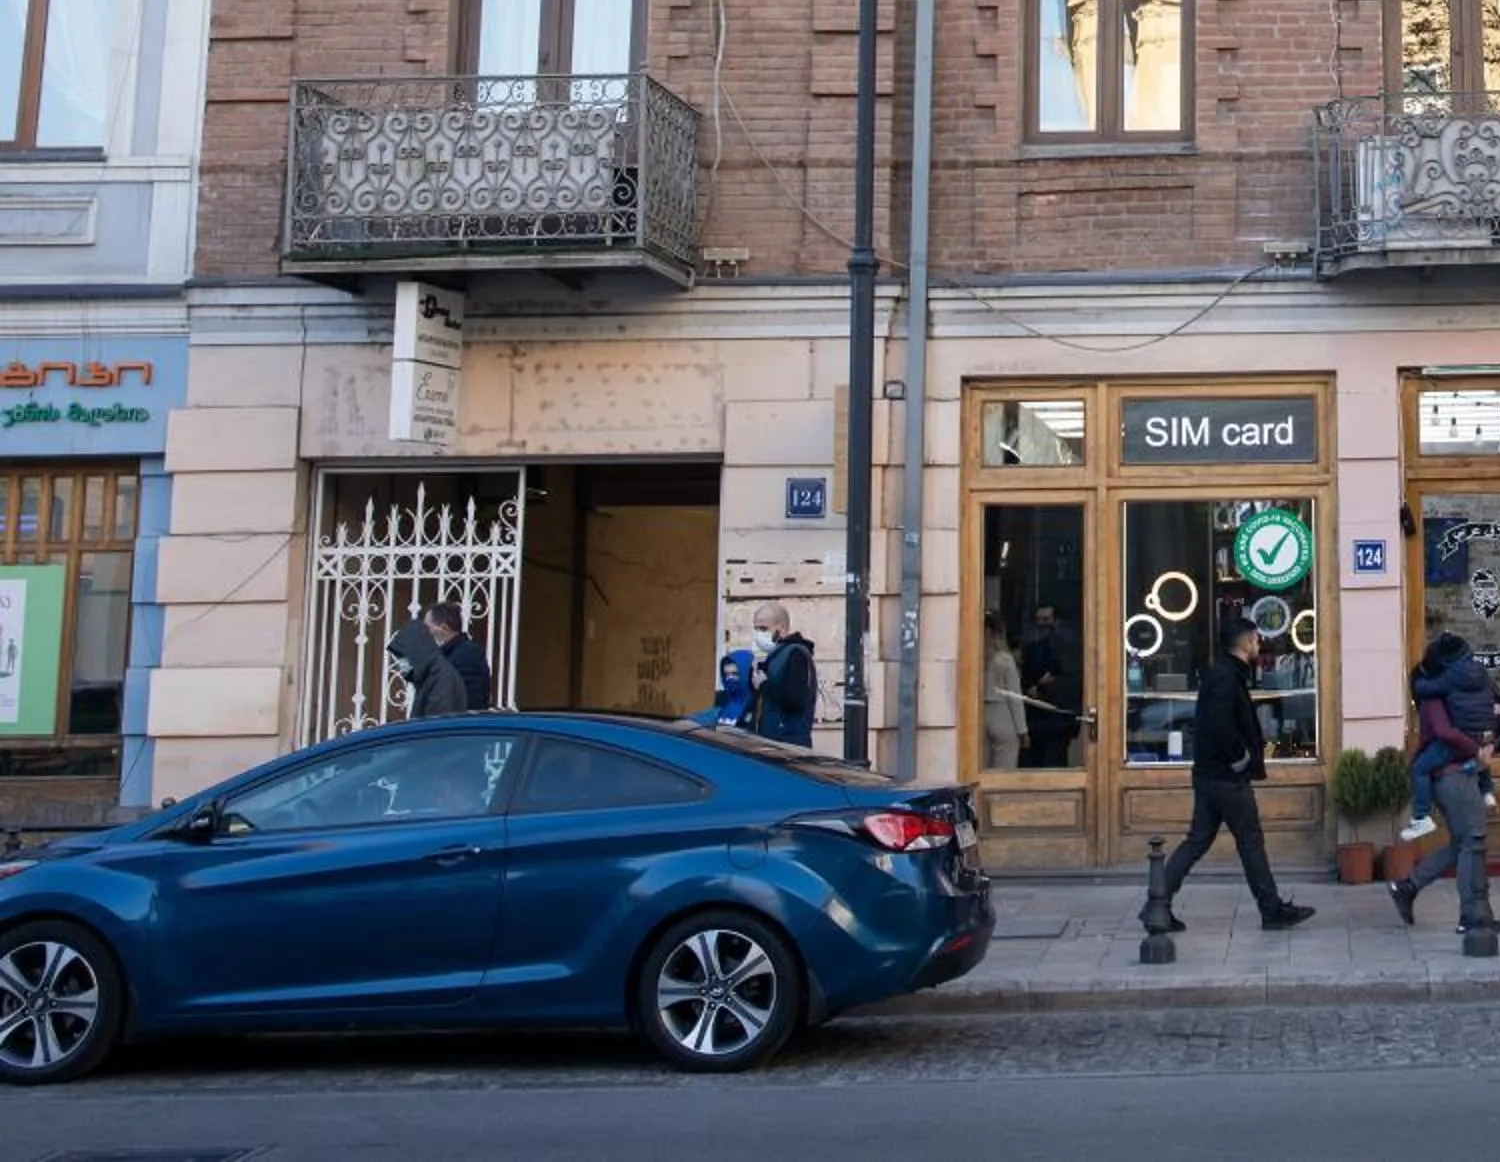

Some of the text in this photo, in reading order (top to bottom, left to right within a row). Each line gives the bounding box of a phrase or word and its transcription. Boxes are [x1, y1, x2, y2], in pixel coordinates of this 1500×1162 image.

[1145, 415, 1294, 447] SIM card
[792, 489, 822, 507] 124
[1356, 547, 1383, 567] 124
